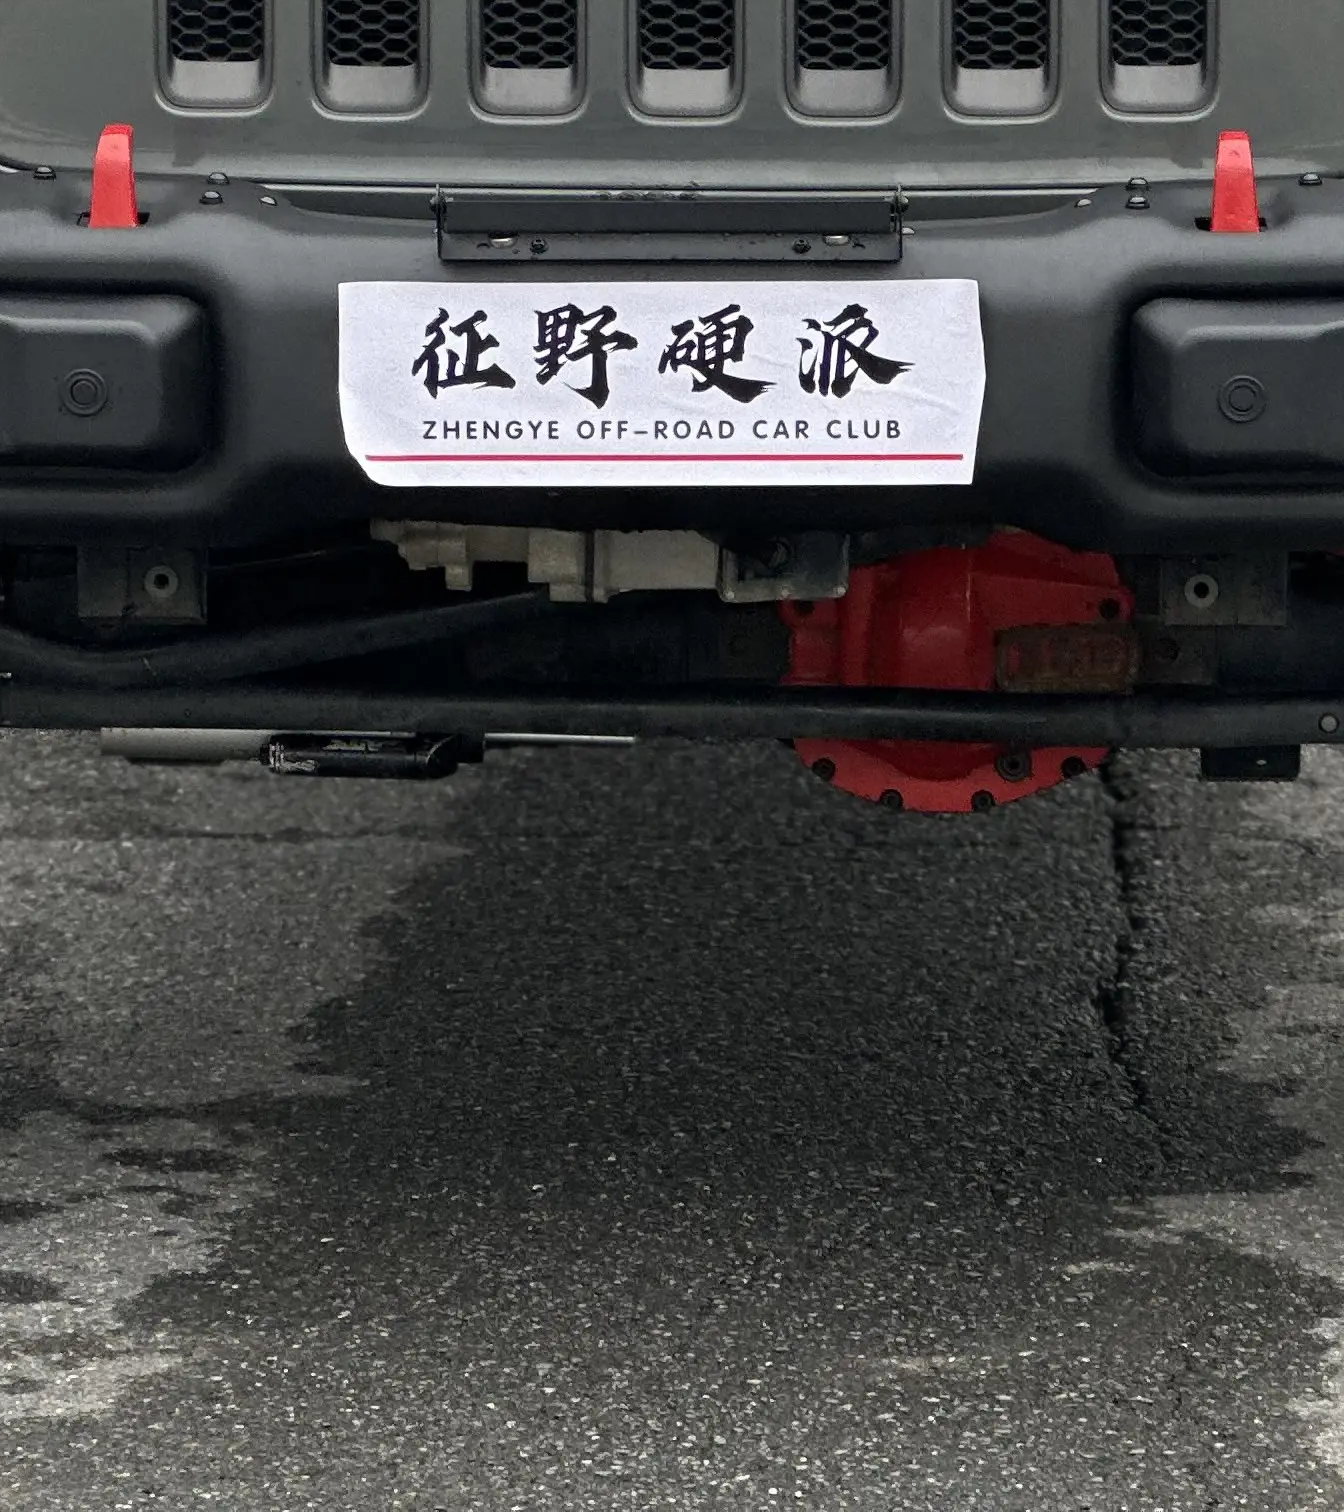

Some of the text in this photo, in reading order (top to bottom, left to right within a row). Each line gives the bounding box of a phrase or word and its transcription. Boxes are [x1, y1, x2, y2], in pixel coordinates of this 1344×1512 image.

[411, 302, 915, 409] 征野硬派
[422, 419, 901, 440] ZHENGYE OFF-ROAD CAR CLUB
